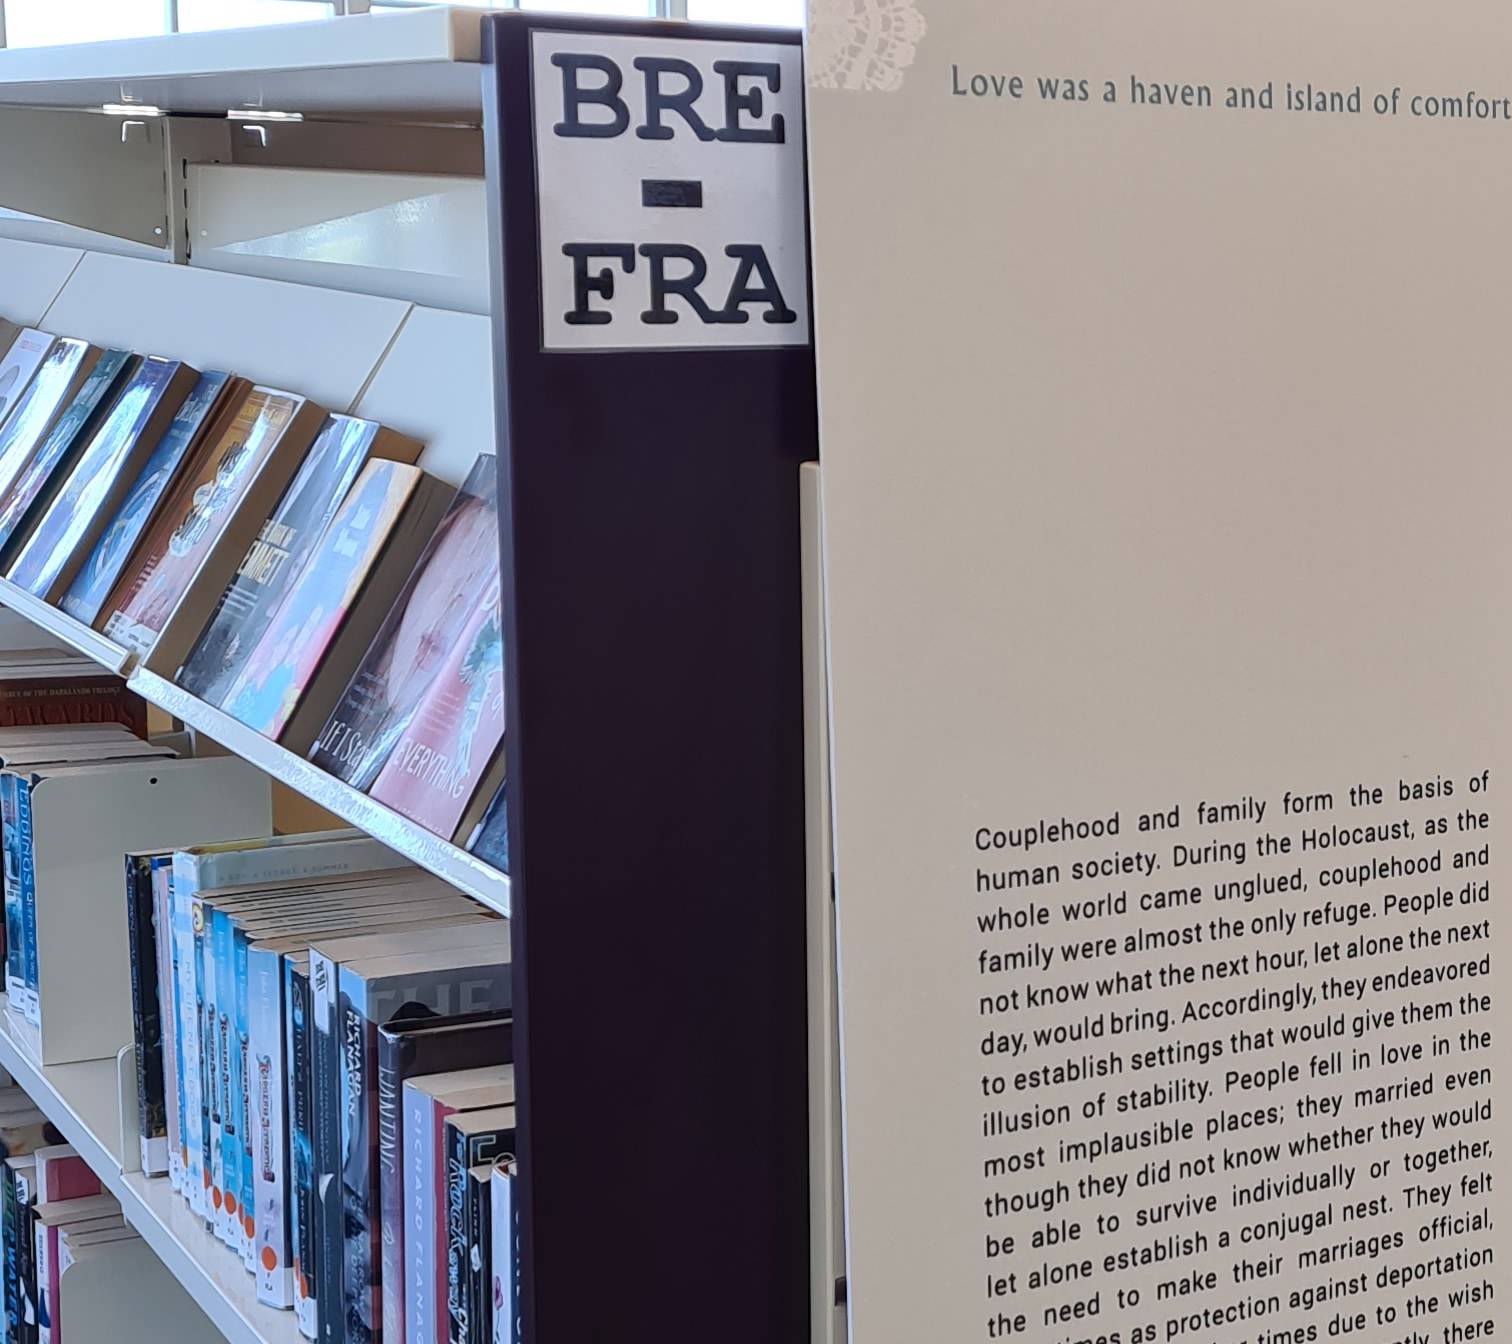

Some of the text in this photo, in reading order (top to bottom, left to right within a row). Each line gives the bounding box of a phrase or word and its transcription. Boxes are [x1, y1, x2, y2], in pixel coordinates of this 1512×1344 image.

[551, 52, 785, 144] BRE
[951, 63, 1023, 98] Love
[1037, 77, 1089, 102] was
[1103, 80, 1116, 103] a
[1130, 75, 1212, 107] haven
[1225, 81, 1273, 110] and
[1286, 83, 1361, 113] island
[1373, 87, 1401, 115] of
[1410, 90, 1511, 119] comfort
[562, 243, 798, 324] FRA
[974, 768, 1490, 852] Couplehood and family form the basis of
[979, 918, 1490, 1016] not know what the next hour, let alone the next
[344, 1008, 358, 1116] FLANAGAN
[350, 1012, 362, 1097] RICHARD
[412, 1107, 424, 1232] RICHARD
[983, 1096, 1492, 1219] though they did not know whether they would
[1165, 1294, 1280, 1343] protection
[1287, 1271, 1368, 1311] against
[1375, 1246, 1493, 1289] deportation
